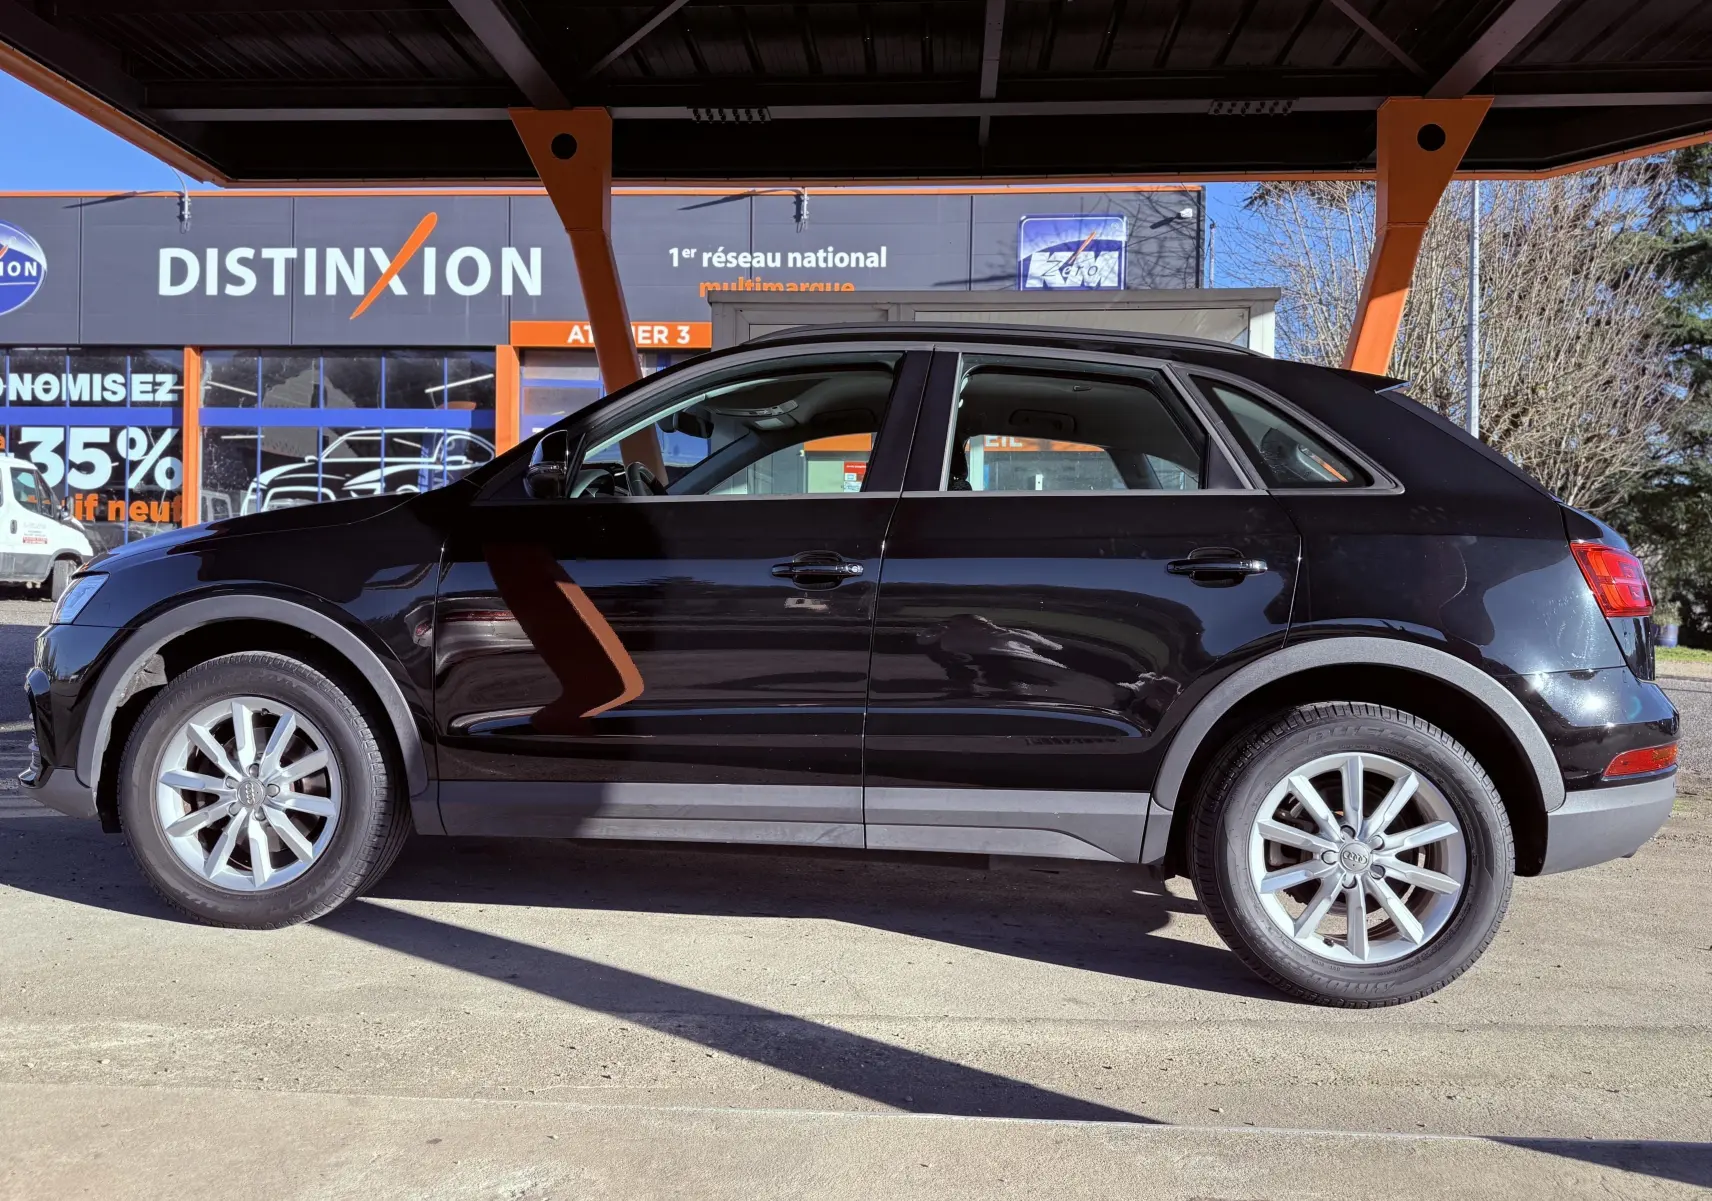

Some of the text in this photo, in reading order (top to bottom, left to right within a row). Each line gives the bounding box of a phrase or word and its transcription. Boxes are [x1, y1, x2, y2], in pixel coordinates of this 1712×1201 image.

[0, 261, 37, 277] ION
[158, 212, 542, 320] DISTINXION
[669, 246, 887, 268] 1er réseau national
[676, 325, 690, 345] 3
[0, 373, 178, 402] NOMISEZ
[108, 493, 182, 523] neuf
